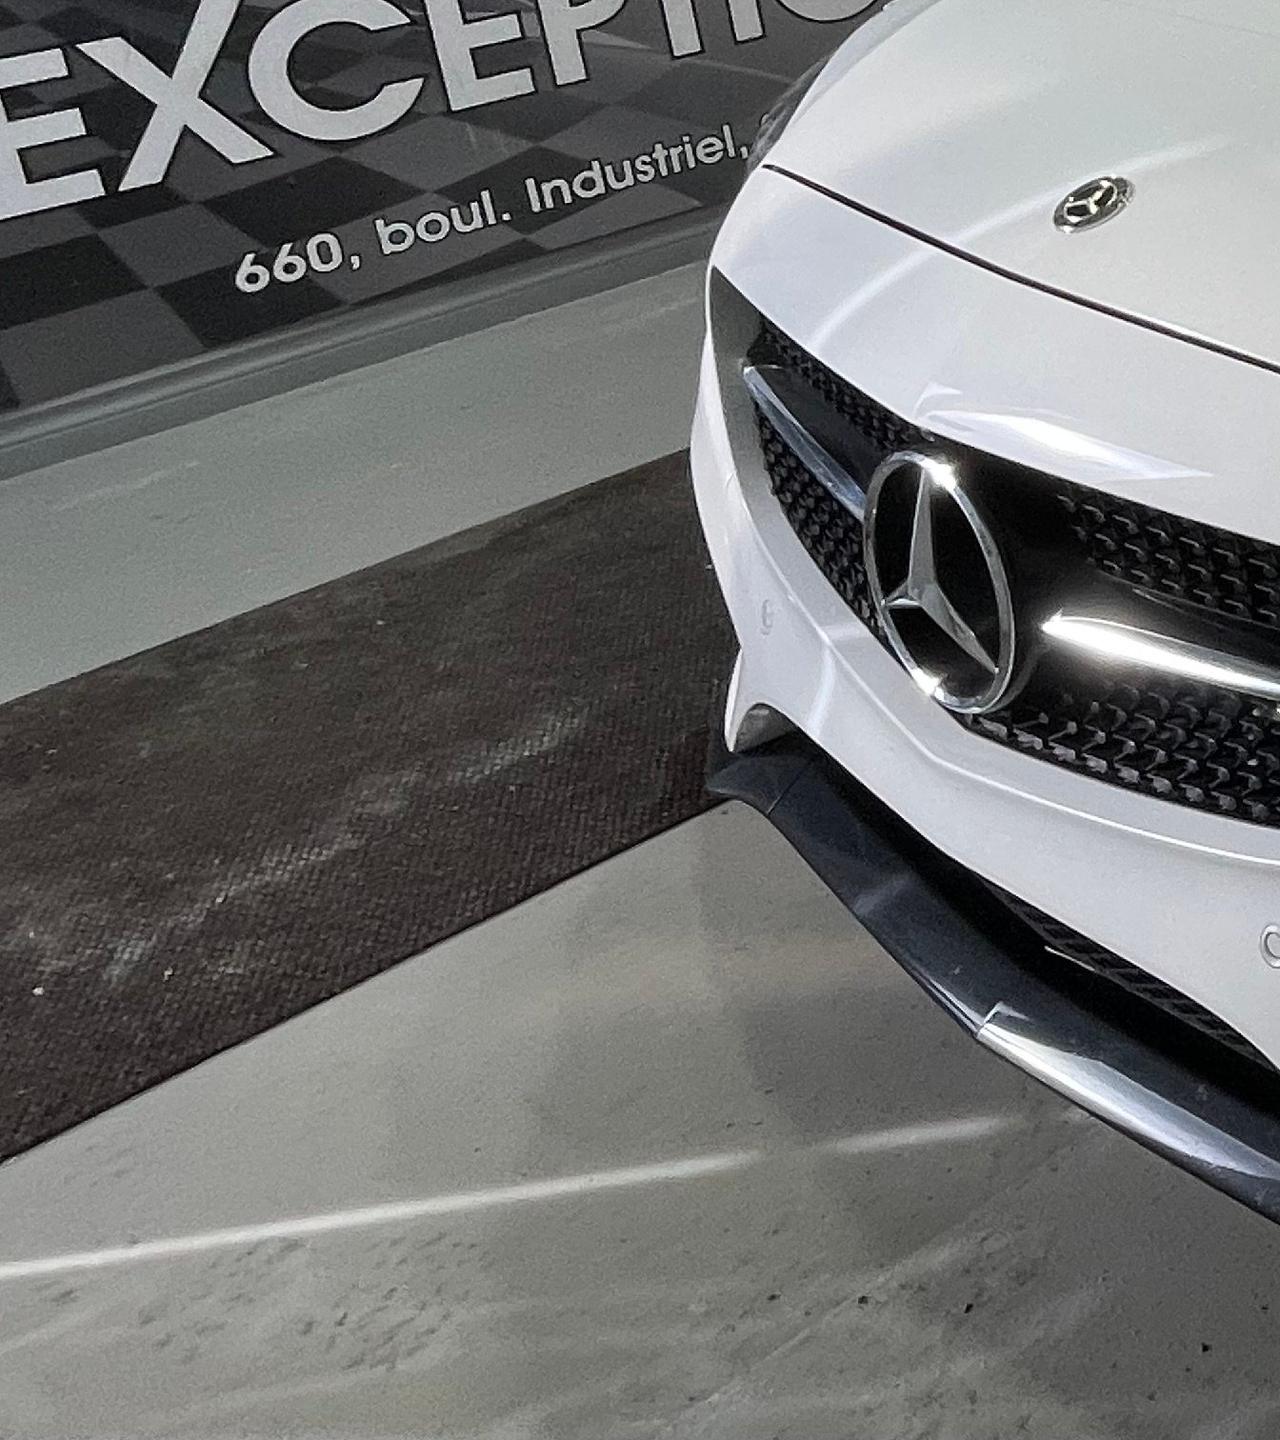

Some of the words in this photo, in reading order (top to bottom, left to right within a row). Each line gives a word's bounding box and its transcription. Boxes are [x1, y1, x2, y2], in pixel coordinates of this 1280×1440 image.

[234, 232, 361, 293] 660,
[374, 189, 512, 255] boul.
[524, 124, 749, 212] Industriel,
